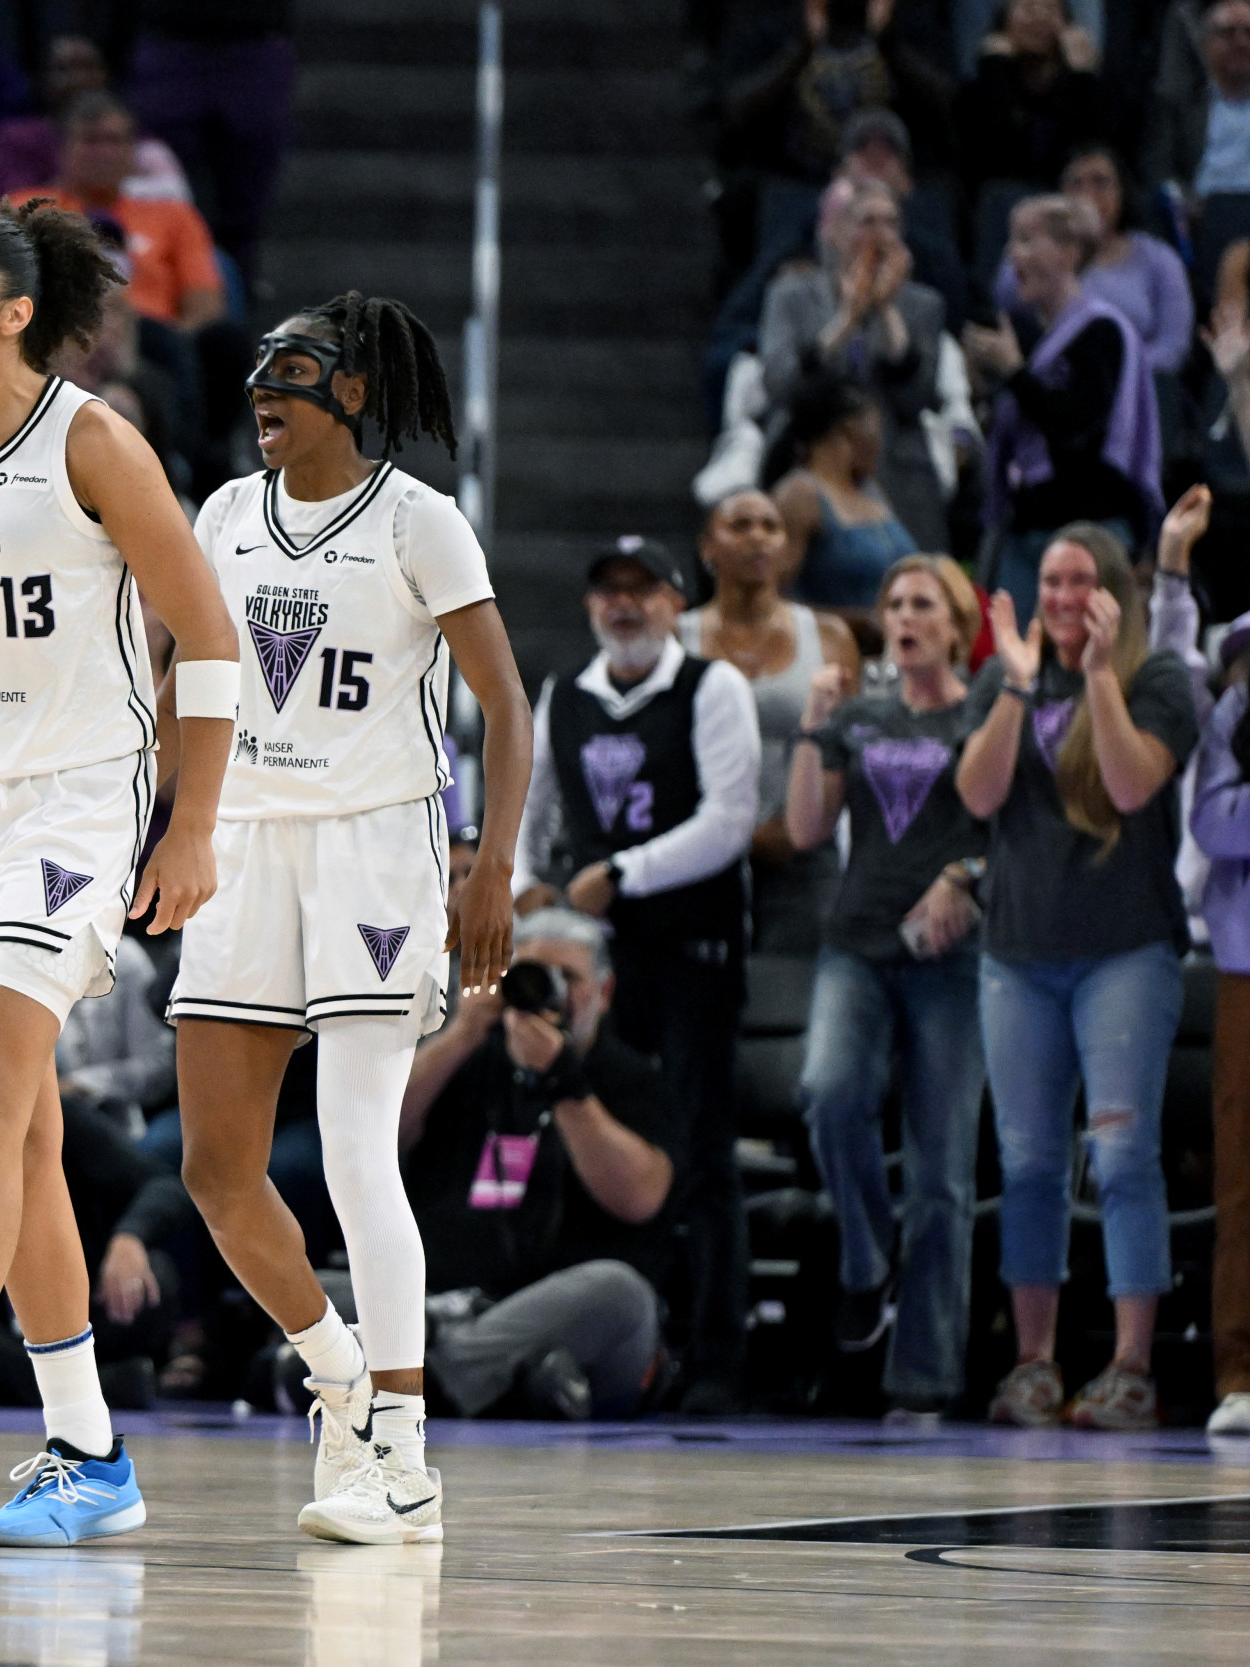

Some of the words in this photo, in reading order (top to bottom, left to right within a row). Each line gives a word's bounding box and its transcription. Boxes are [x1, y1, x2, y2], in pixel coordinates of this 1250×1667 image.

[11, 473, 48, 485] freedom
[340, 552, 376, 564] freedom
[256, 583, 290, 598] GOLDEN
[292, 587, 320, 601] STATE
[0, 573, 55, 638] 13
[245, 595, 329, 632] VALKYRIES
[318, 646, 375, 712] 15
[264, 741, 294, 753] KAISER
[263, 756, 330, 769] PERMANENTE
